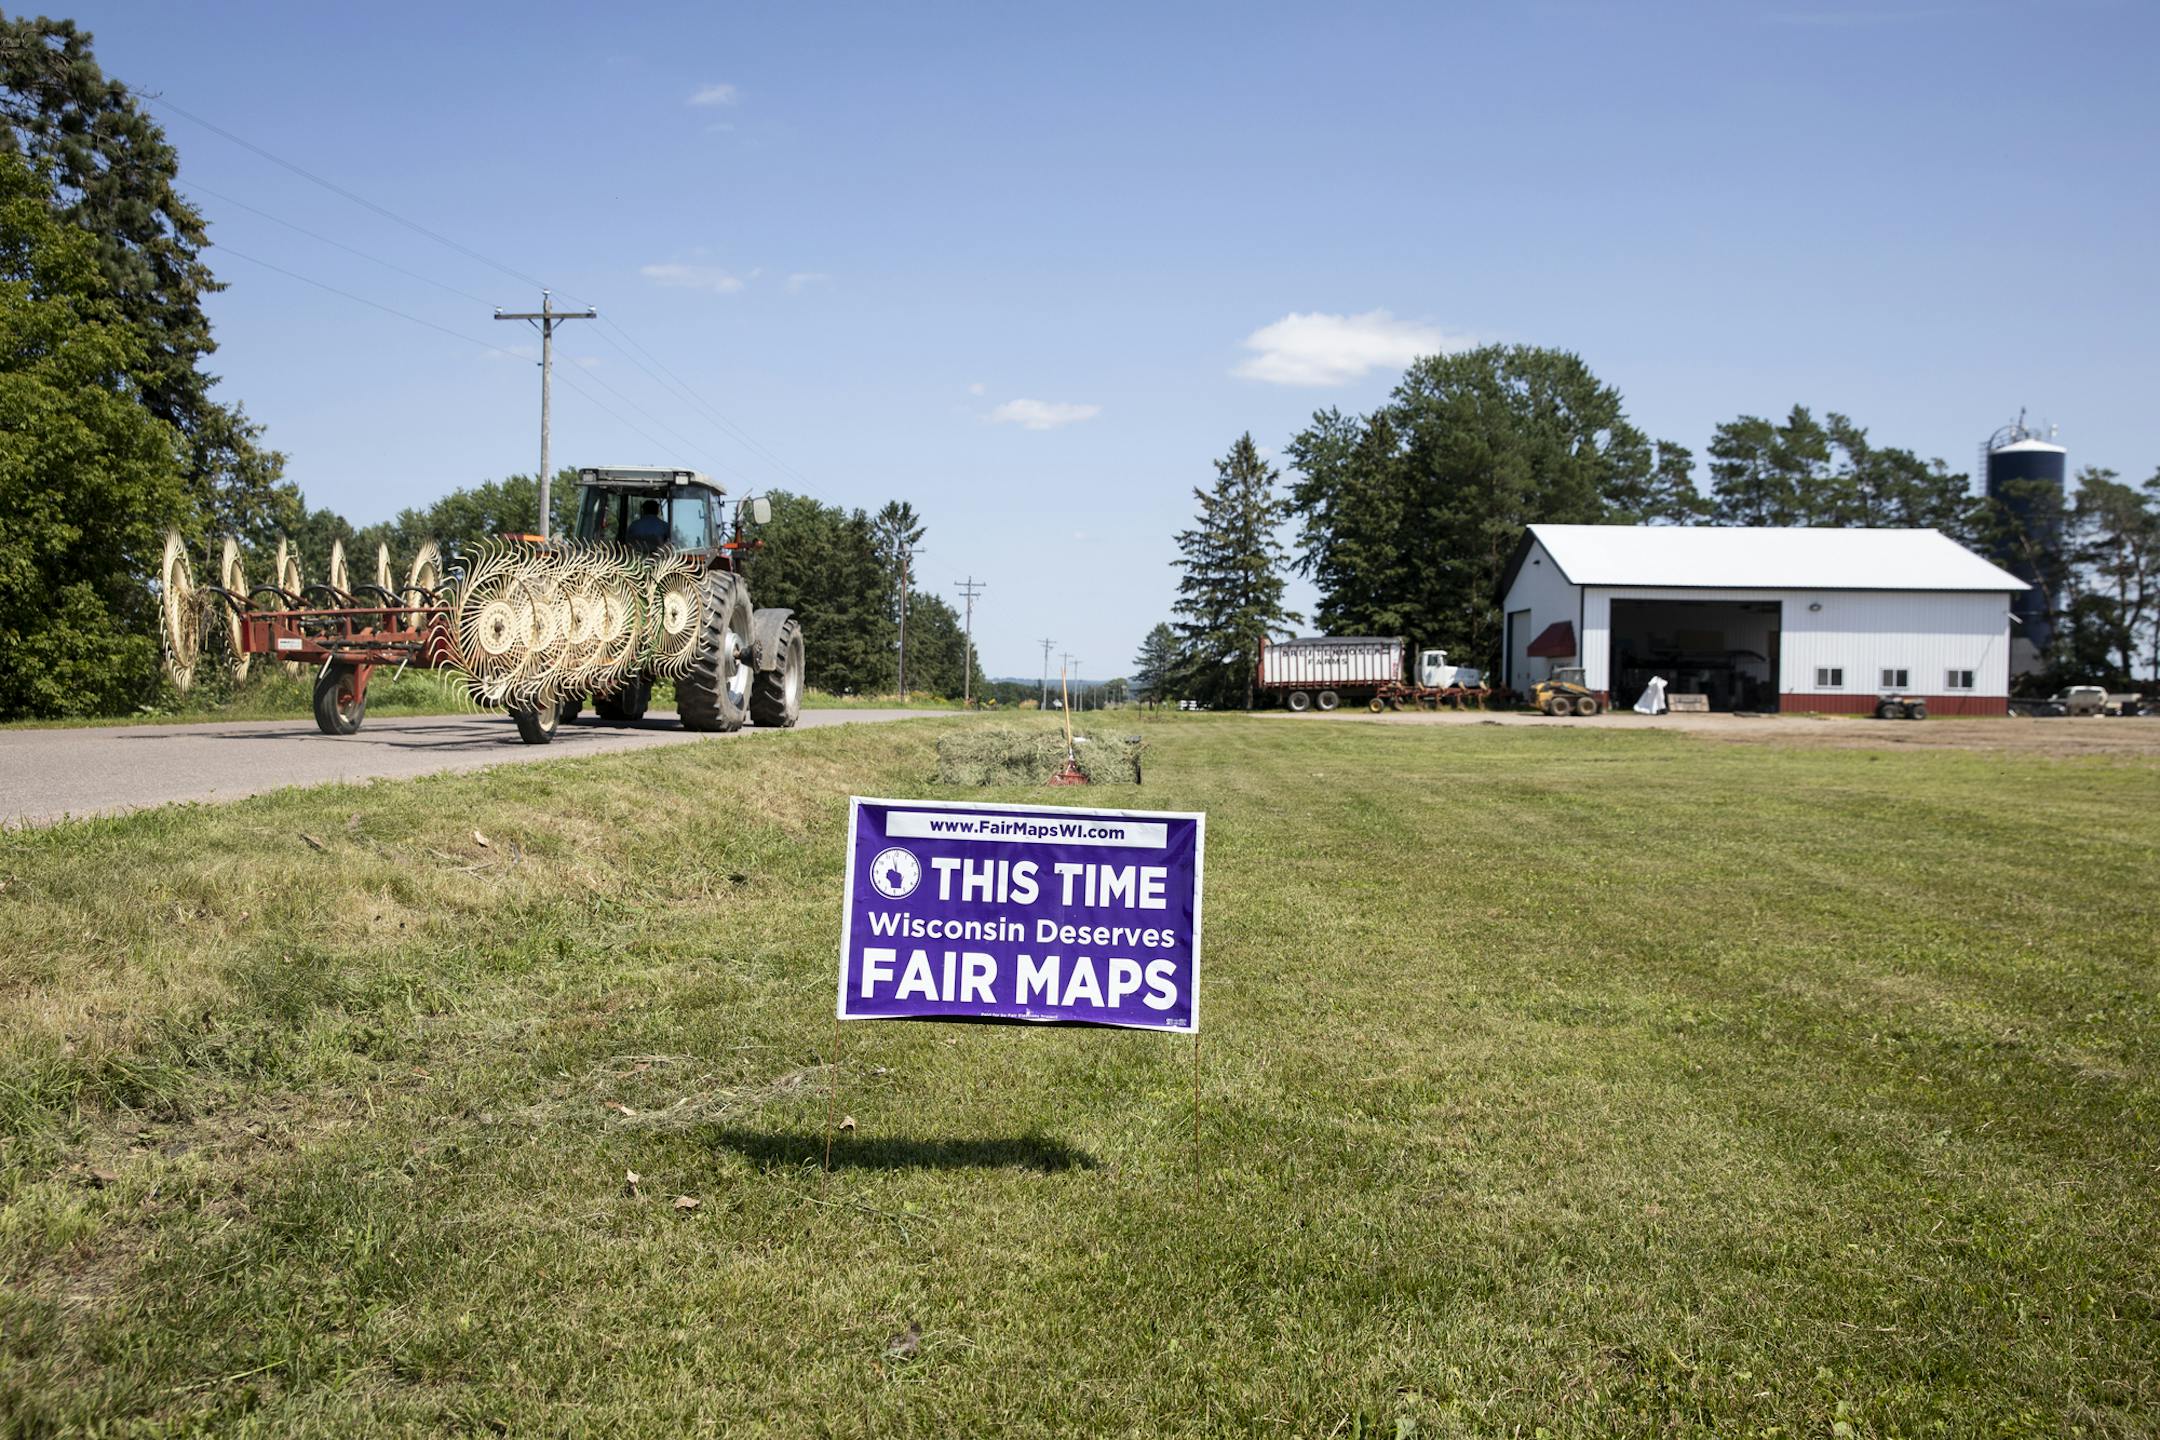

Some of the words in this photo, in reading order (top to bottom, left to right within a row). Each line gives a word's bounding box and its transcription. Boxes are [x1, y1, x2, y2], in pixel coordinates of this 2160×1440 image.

[930, 820, 1125, 840] www.FairMapsWI.com
[932, 857, 1039, 904] THIS
[1054, 862, 1168, 910] TIME
[868, 911, 1025, 942] Wisconsin
[1037, 918, 1175, 948] Deserves
[861, 947, 998, 1004] FAIR
[1015, 954, 1178, 1011] MAPS
